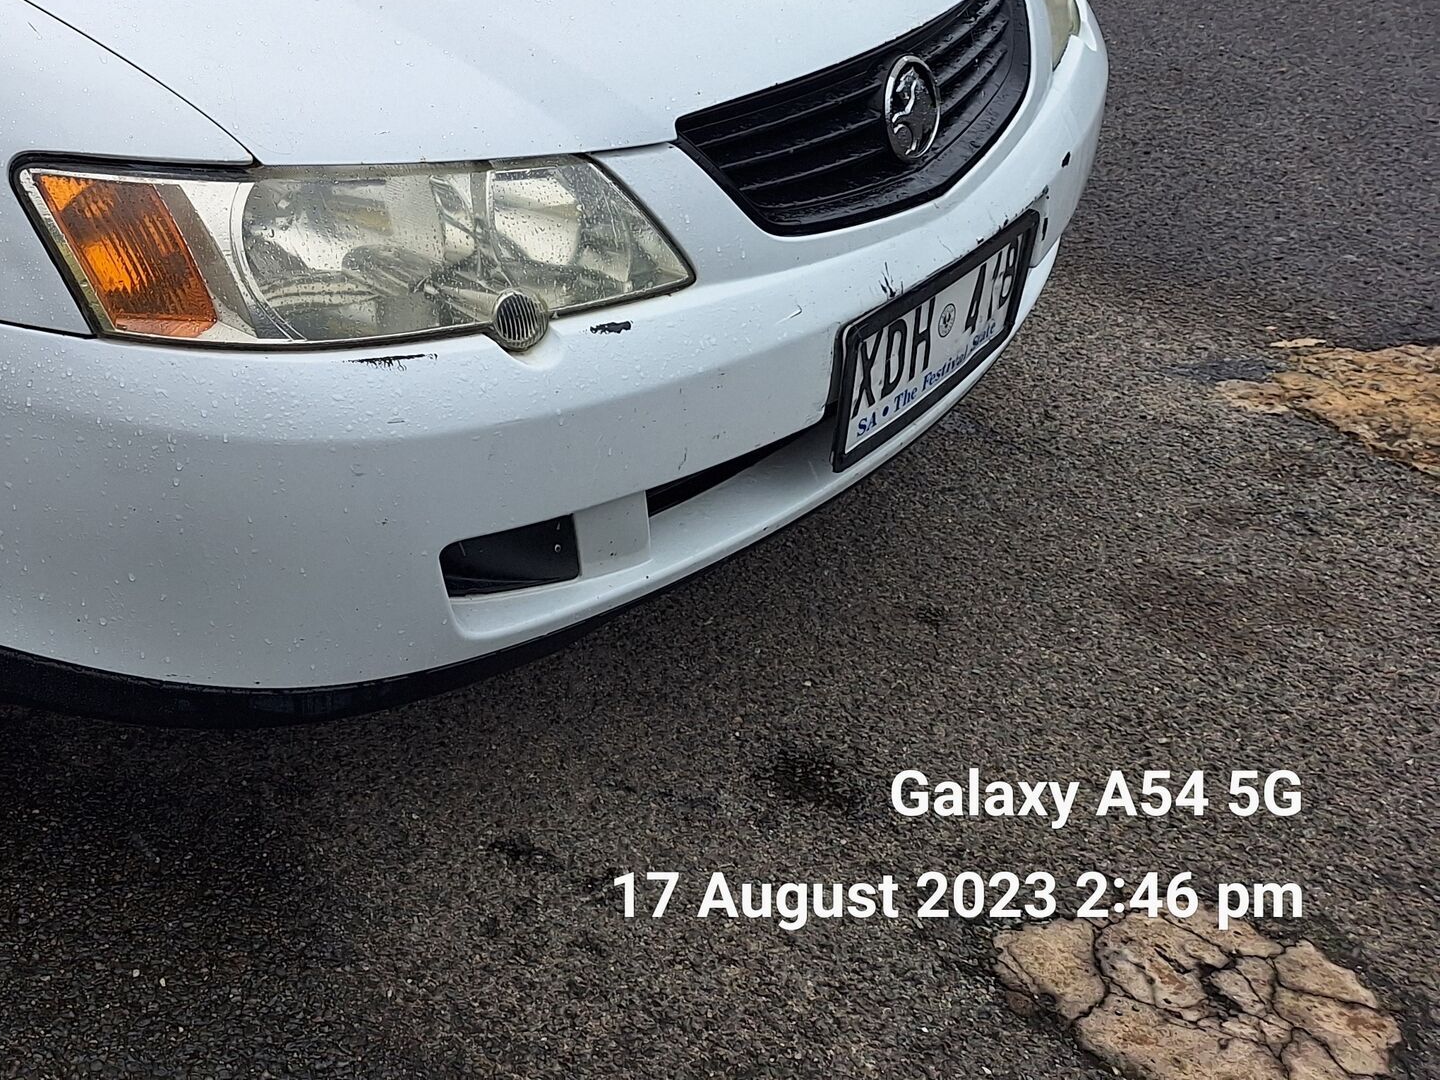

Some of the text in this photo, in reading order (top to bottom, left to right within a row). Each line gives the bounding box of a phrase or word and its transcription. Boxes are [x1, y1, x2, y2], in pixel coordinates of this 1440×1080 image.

[852, 296, 936, 420] XDH
[856, 411, 878, 437] SA
[893, 386, 918, 422] The
